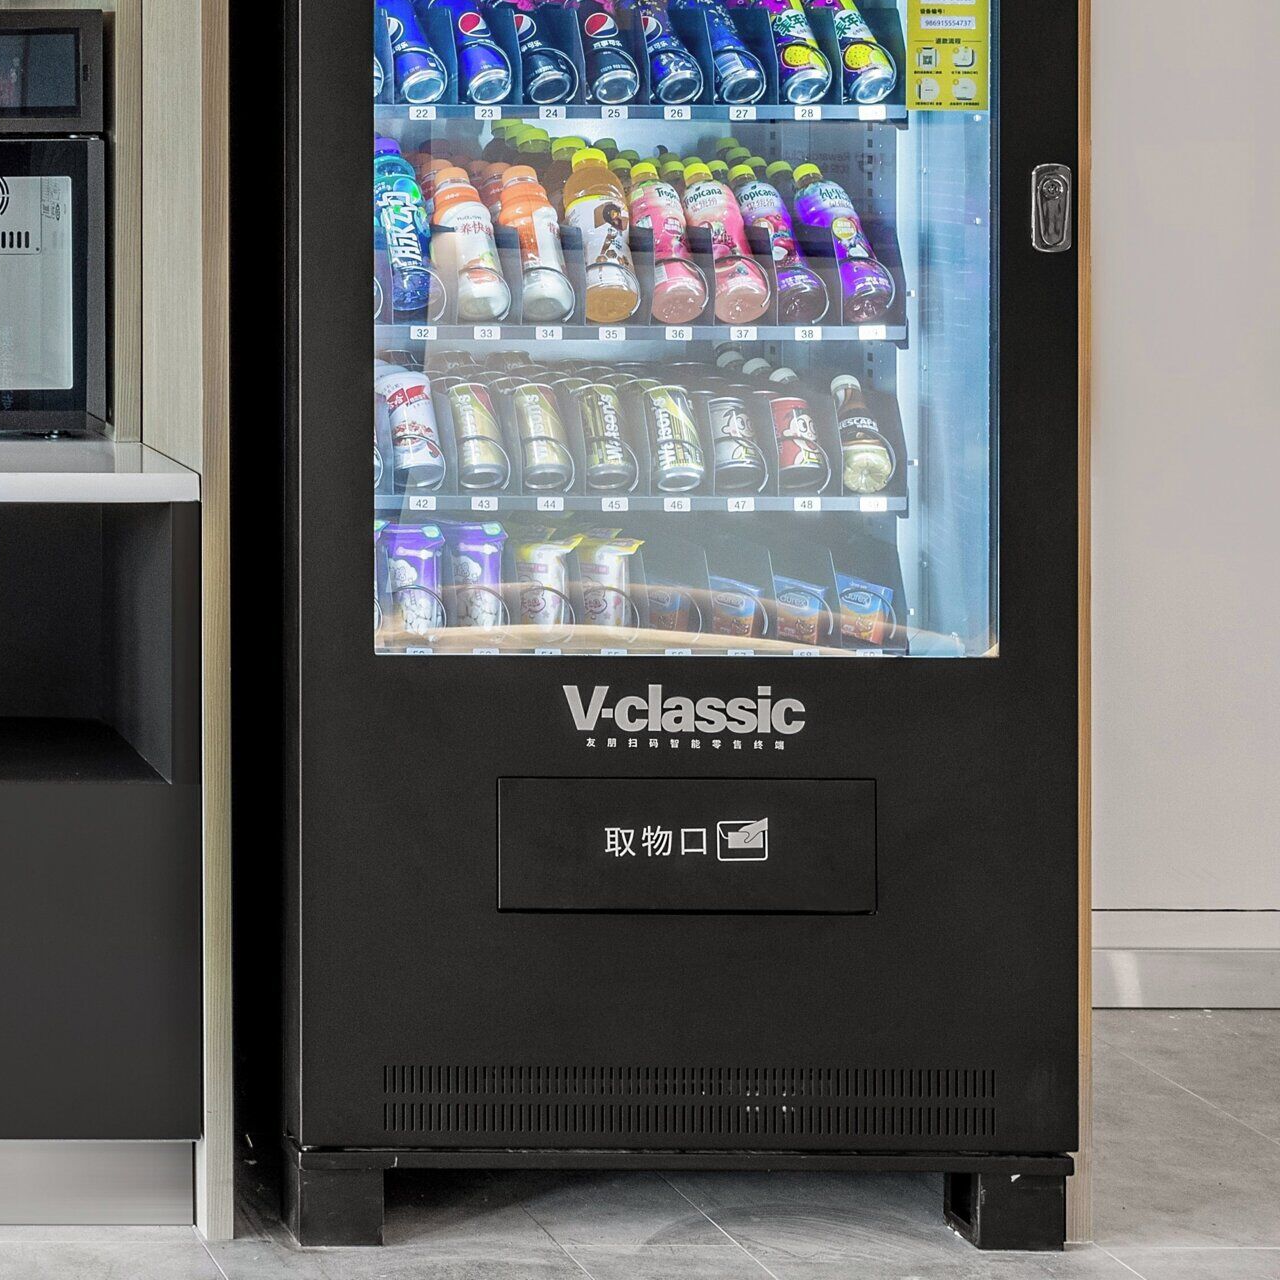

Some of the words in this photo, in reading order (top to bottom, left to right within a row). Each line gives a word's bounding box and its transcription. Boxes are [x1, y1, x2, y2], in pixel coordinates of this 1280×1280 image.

[415, 108, 428, 118] 22
[481, 108, 494, 118] 23
[545, 108, 558, 118] 24
[608, 108, 621, 118] 25
[670, 108, 683, 118] 26
[736, 108, 749, 118] 27
[801, 108, 814, 118] 28
[416, 328, 429, 337] 32
[480, 329, 493, 338] 33
[542, 329, 555, 338] 34
[605, 329, 618, 338] 35
[671, 329, 684, 338] 36
[736, 329, 749, 338] 37
[801, 329, 814, 338] 38
[415, 499, 428, 508] 42
[477, 499, 490, 508] 43
[543, 499, 556, 508] 44
[608, 500, 621, 509] 45
[670, 500, 683, 509] 46
[734, 500, 747, 509] 47
[800, 500, 813, 509] 48
[562, 684, 806, 735] V-classic
[586, 737, 785, 751] 友朋扫码智能零售终端
[604, 825, 708, 857] 取物口
